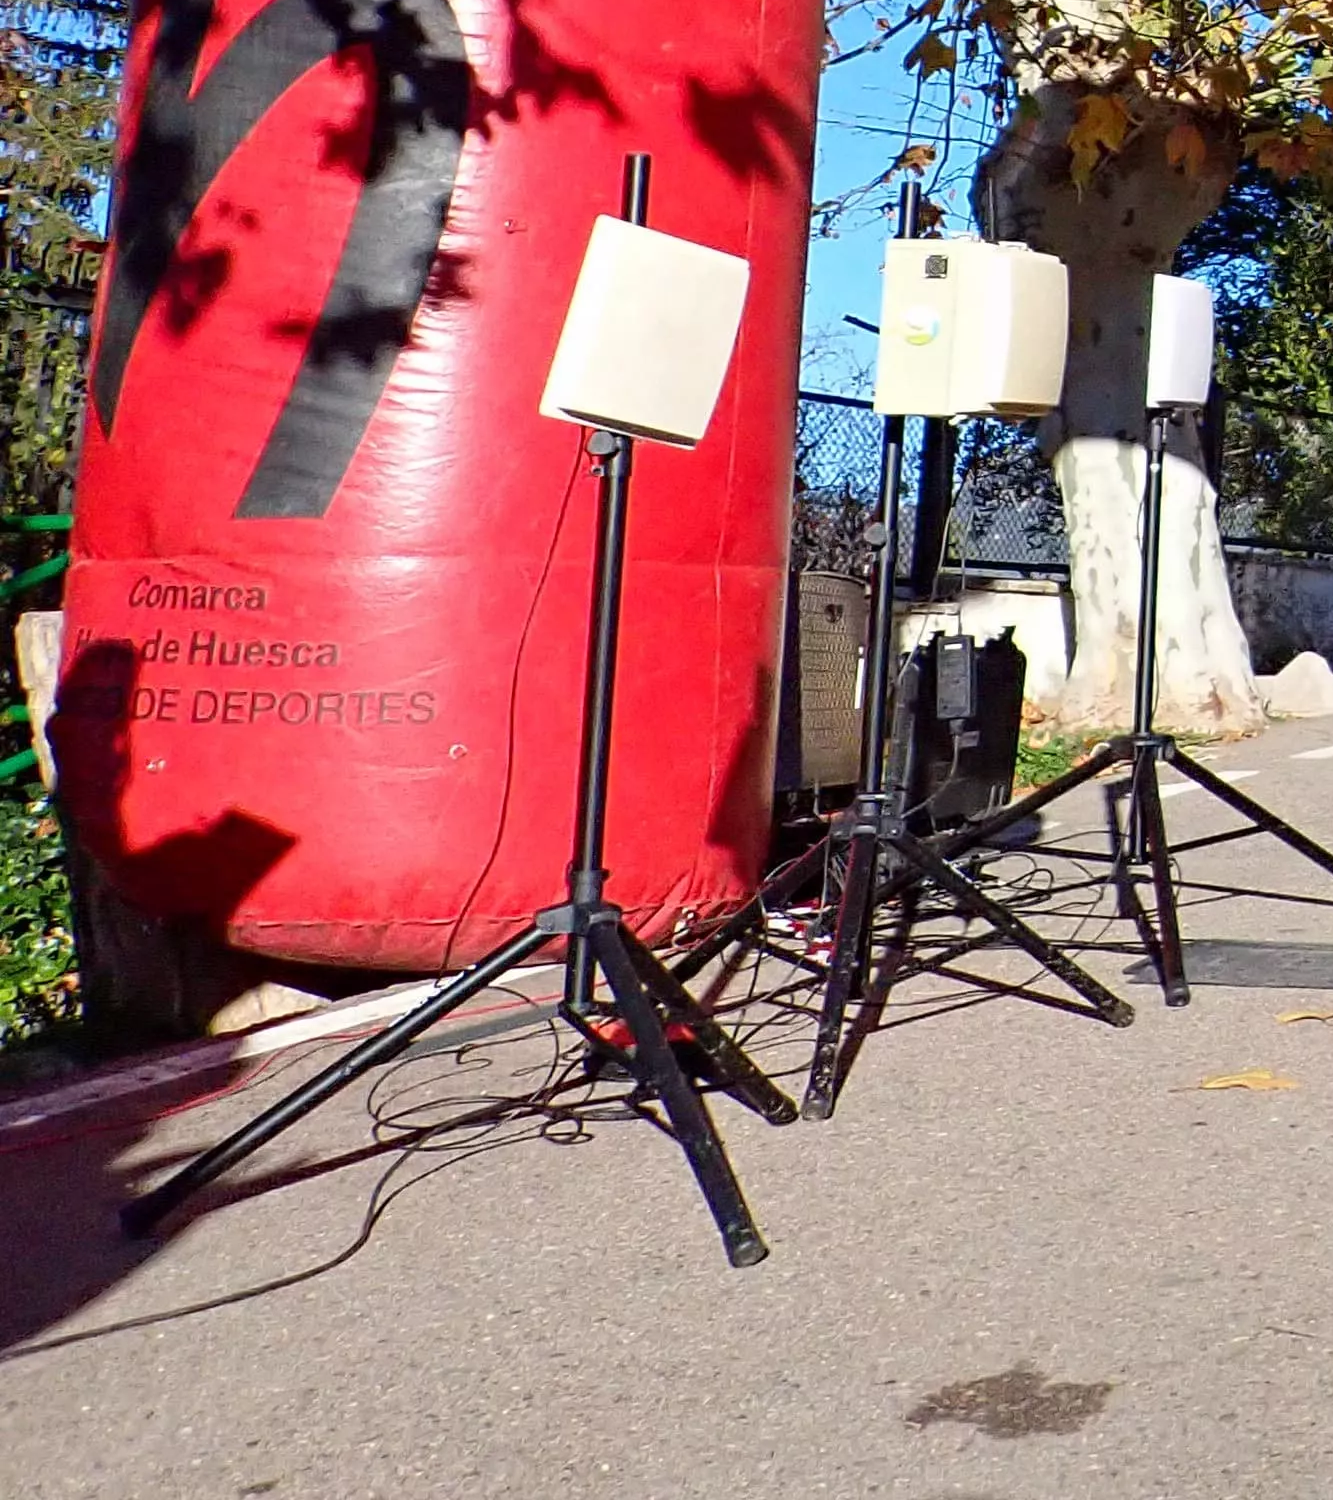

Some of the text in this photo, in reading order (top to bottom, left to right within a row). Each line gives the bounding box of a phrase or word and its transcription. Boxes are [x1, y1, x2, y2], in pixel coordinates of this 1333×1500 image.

[128, 575, 267, 611] Comarca
[142, 628, 180, 663] de
[188, 631, 340, 668] Huesca
[132, 688, 181, 722] DE
[190, 689, 437, 726] DEPORTES
